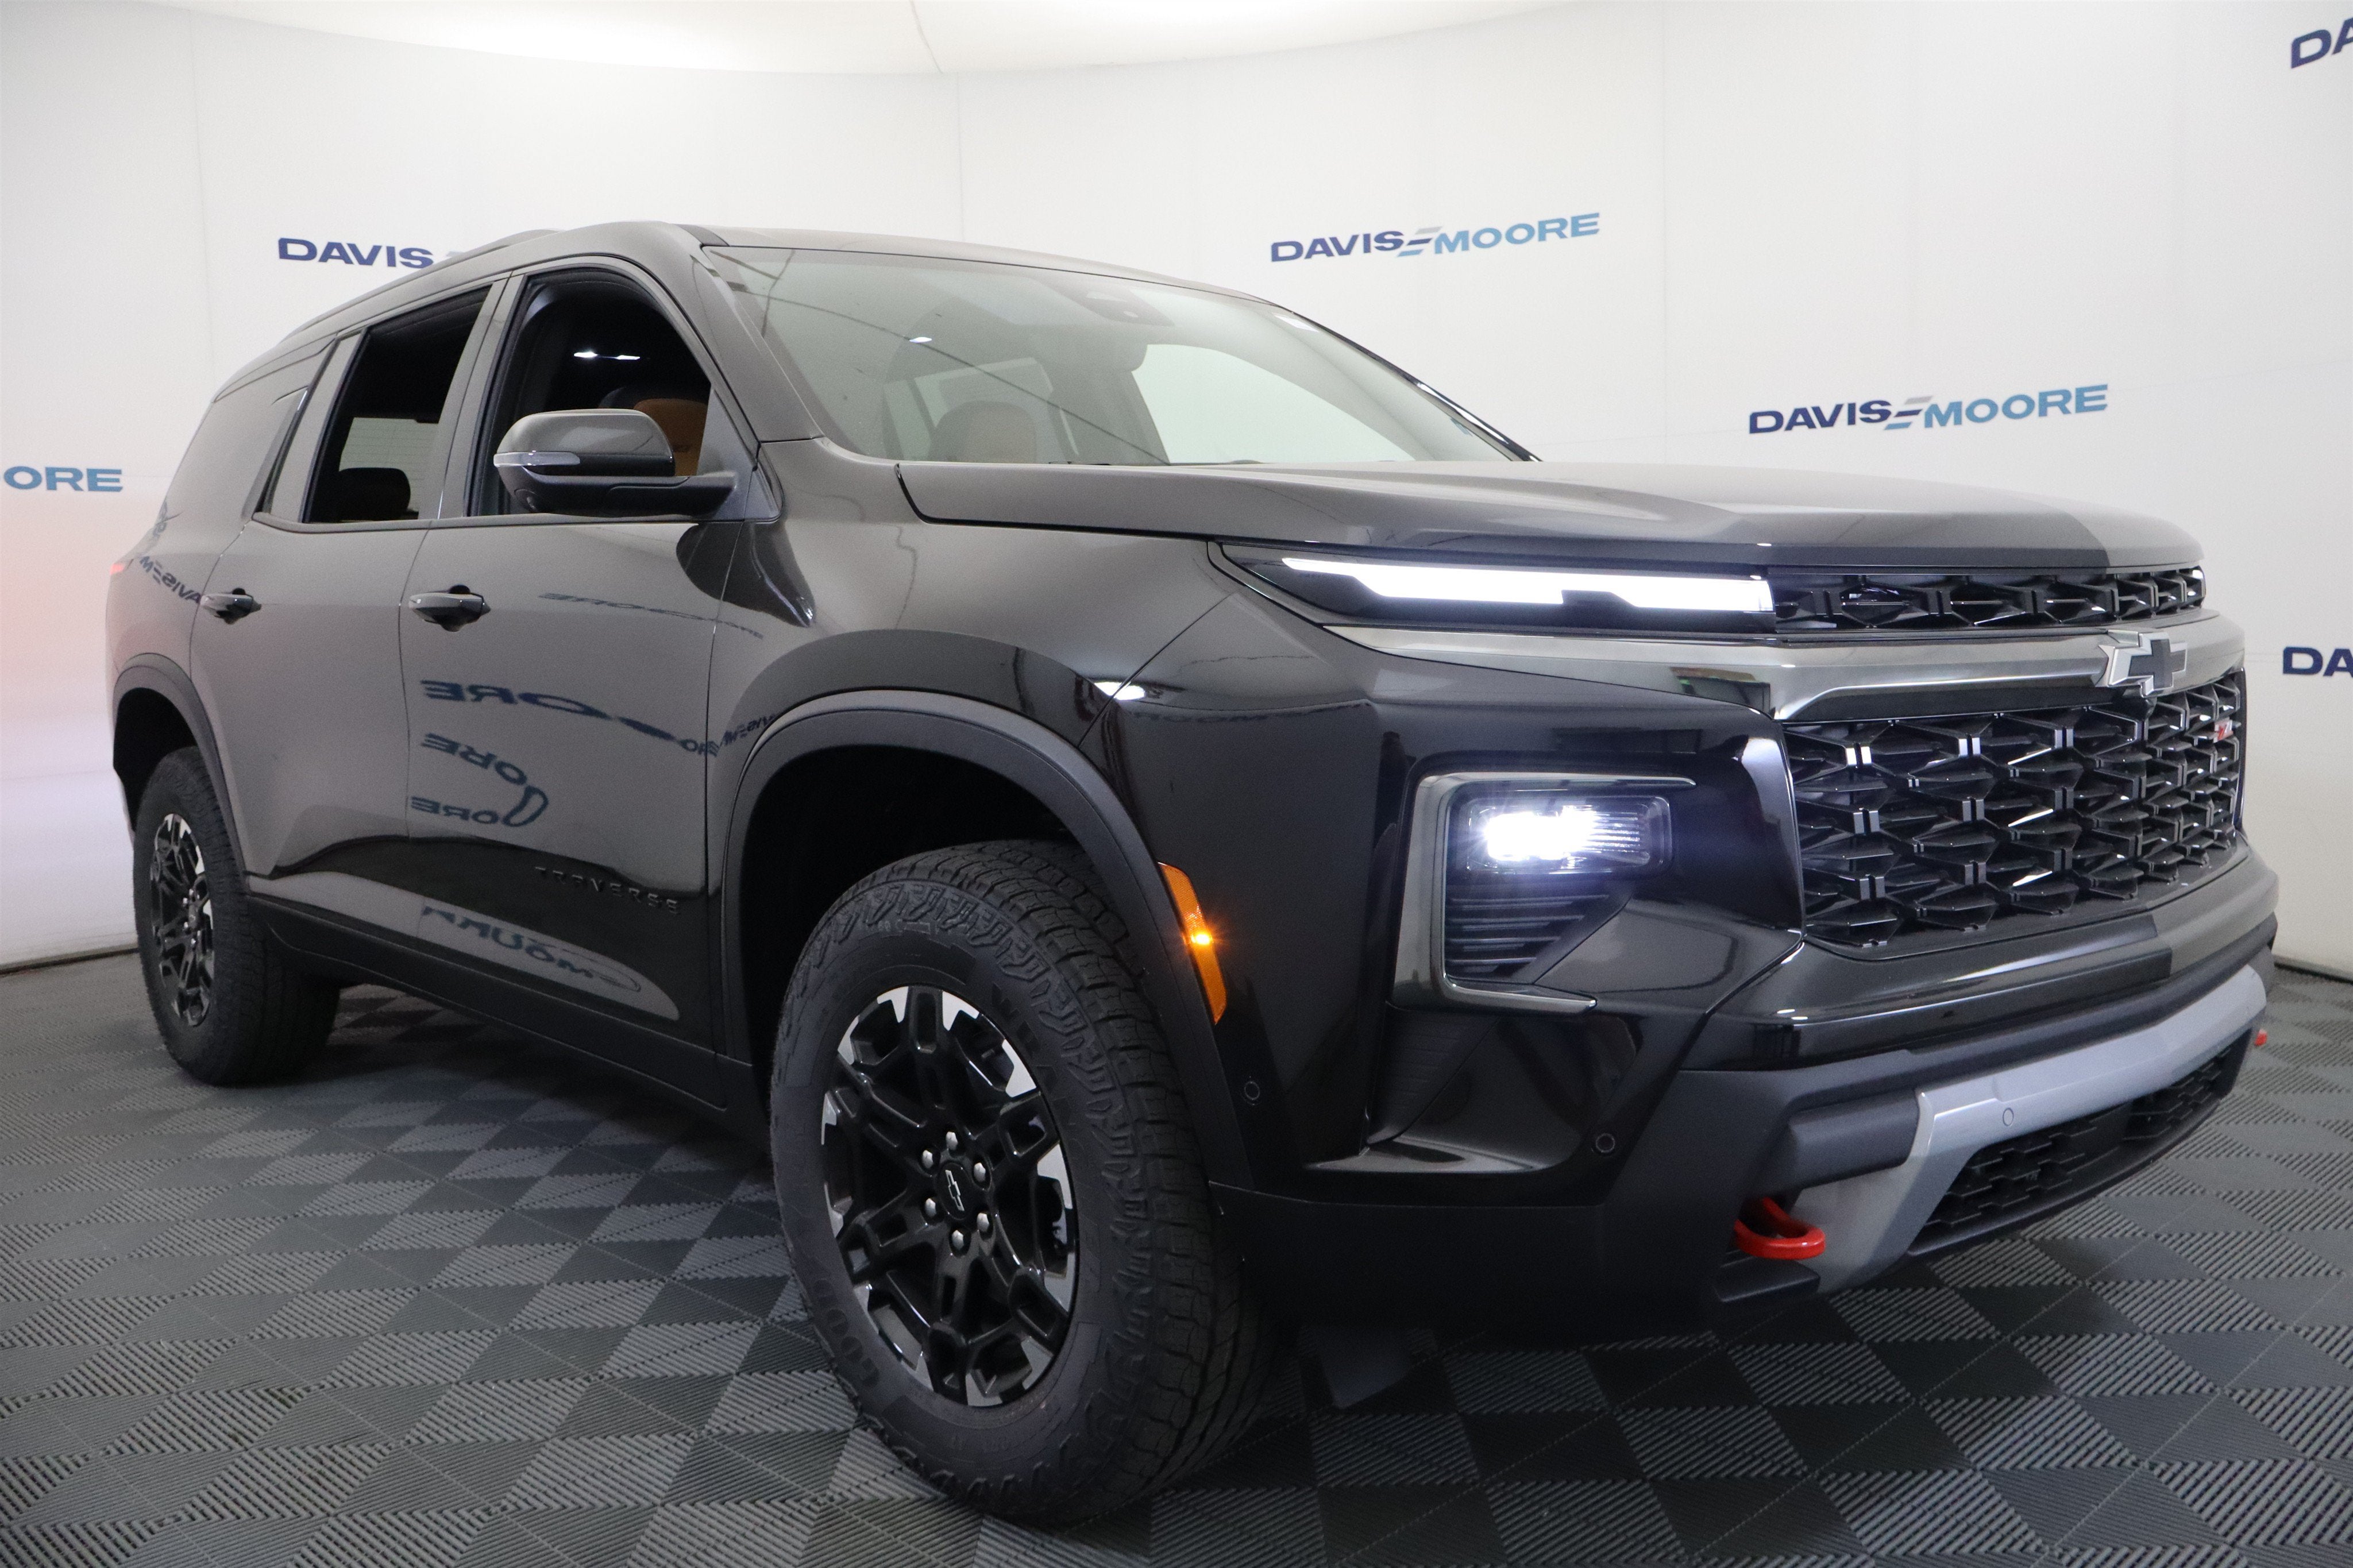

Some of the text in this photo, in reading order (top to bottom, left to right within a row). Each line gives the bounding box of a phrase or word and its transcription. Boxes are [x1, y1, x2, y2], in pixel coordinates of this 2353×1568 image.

[278, 237, 433, 269] DAVIS
[1271, 212, 1600, 262] DAVIS MOORE
[1749, 384, 2108, 434] DAVIS MOORE
[3, 466, 123, 492] ORE
